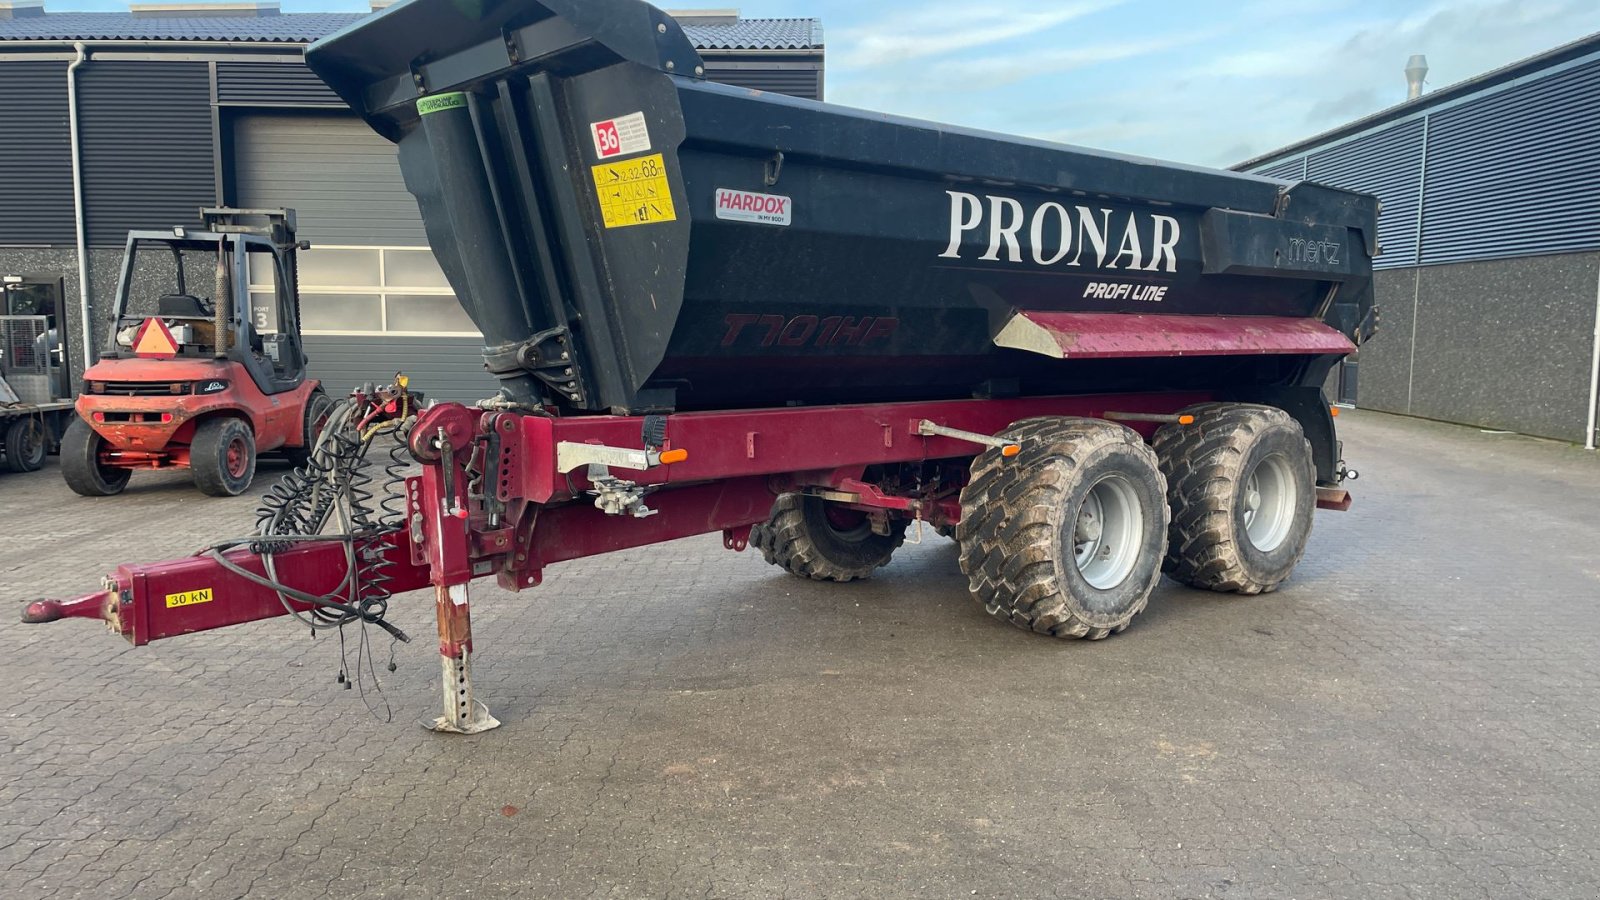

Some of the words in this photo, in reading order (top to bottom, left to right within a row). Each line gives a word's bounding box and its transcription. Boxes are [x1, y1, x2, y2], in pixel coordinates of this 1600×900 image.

[599, 127, 618, 150] 36
[719, 192, 785, 214] HARDOX
[938, 190, 1180, 273] PRONAR
[1288, 236, 1341, 265] mertz
[1083, 282, 1132, 300] PROFI
[1132, 285, 1169, 302] LINE
[256, 312, 268, 328] 3
[171, 594, 186, 605] 30
[191, 591, 208, 602] kN
